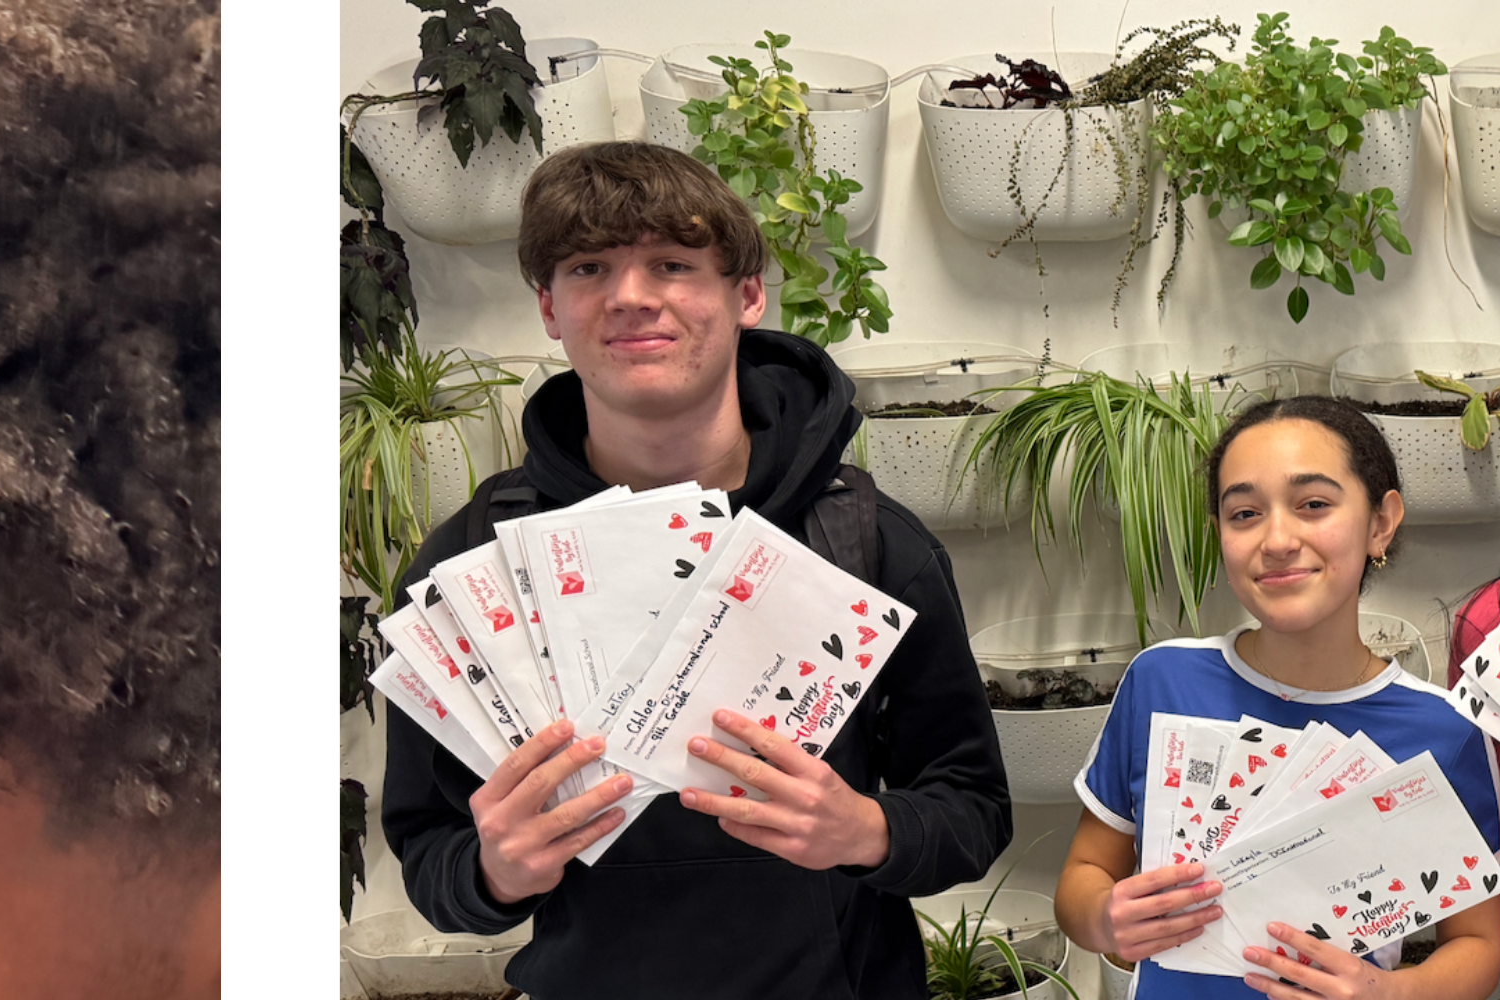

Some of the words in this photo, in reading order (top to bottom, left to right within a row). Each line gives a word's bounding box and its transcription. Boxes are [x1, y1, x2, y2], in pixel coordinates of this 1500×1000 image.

[627, 698, 657, 734] Chloe
[785, 682, 819, 726] Happy
[819, 693, 846, 729] Day
[1352, 899, 1398, 923] Happy
[1377, 914, 1411, 940] Day
